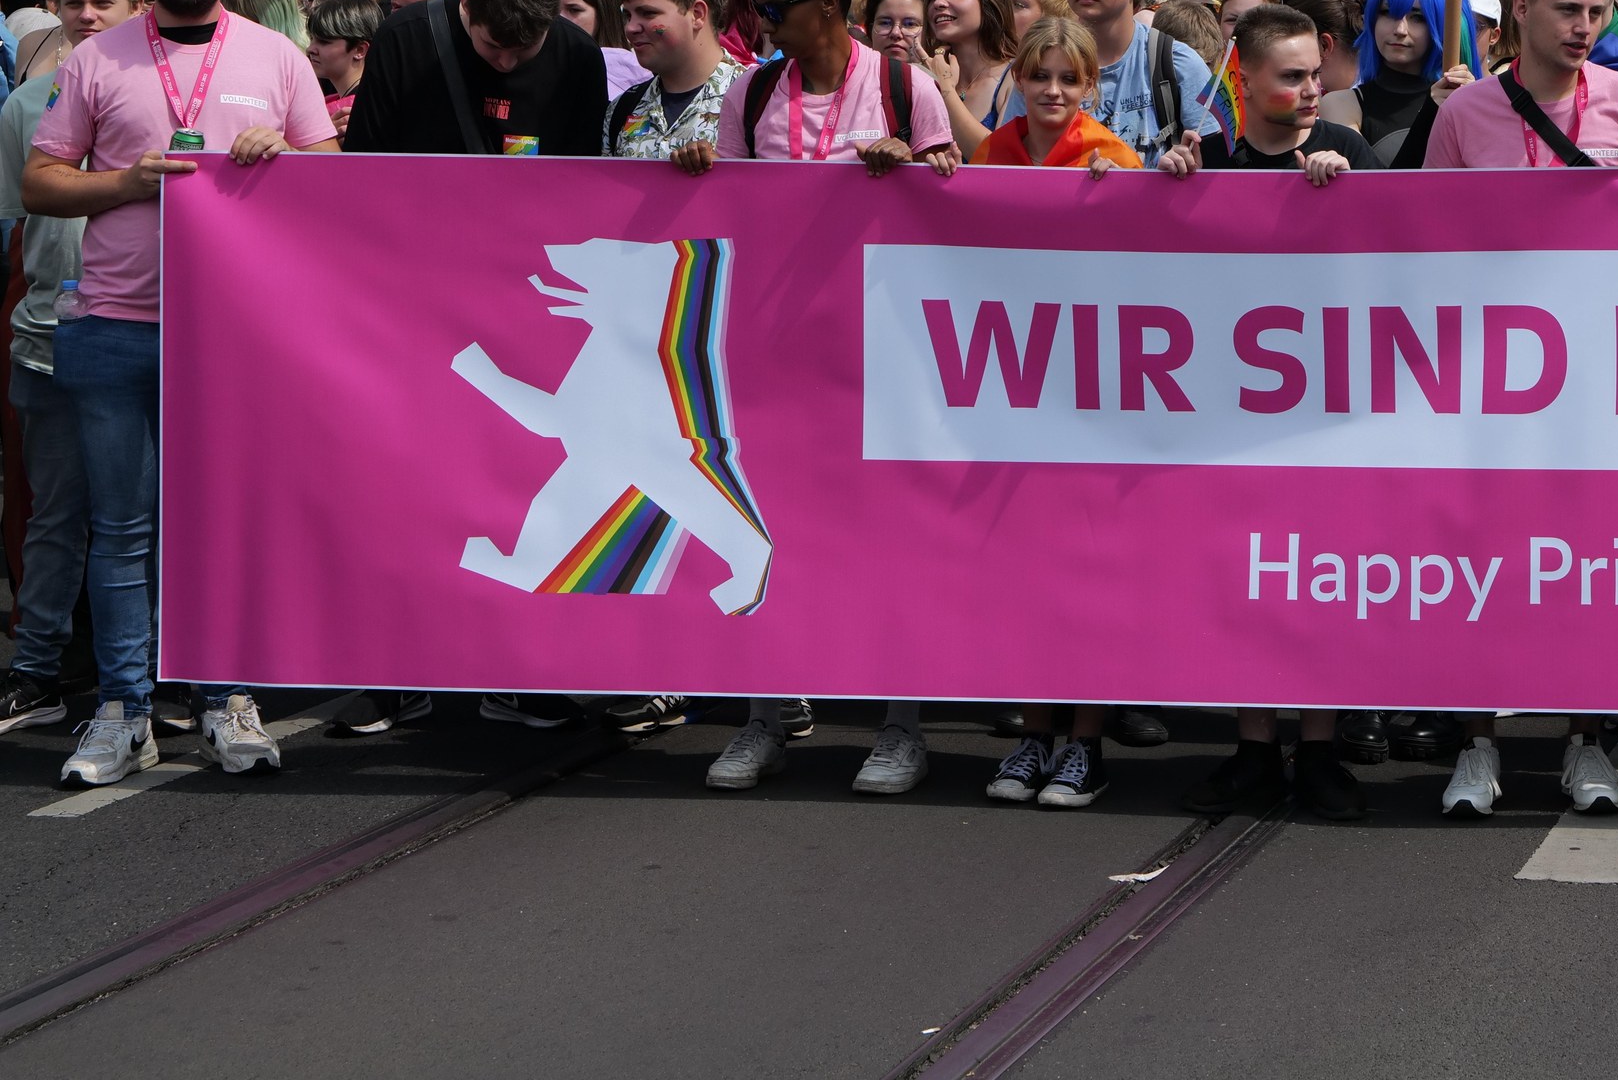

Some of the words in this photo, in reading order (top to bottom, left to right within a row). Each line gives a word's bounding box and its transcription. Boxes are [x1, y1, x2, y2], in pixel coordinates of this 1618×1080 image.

[221, 95, 267, 109] VOLUNTEER
[1120, 93, 1153, 106] UNLIMIT
[920, 298, 1197, 413] WIR
[1232, 305, 1569, 416] SIND
[1248, 532, 1504, 622] Happy
